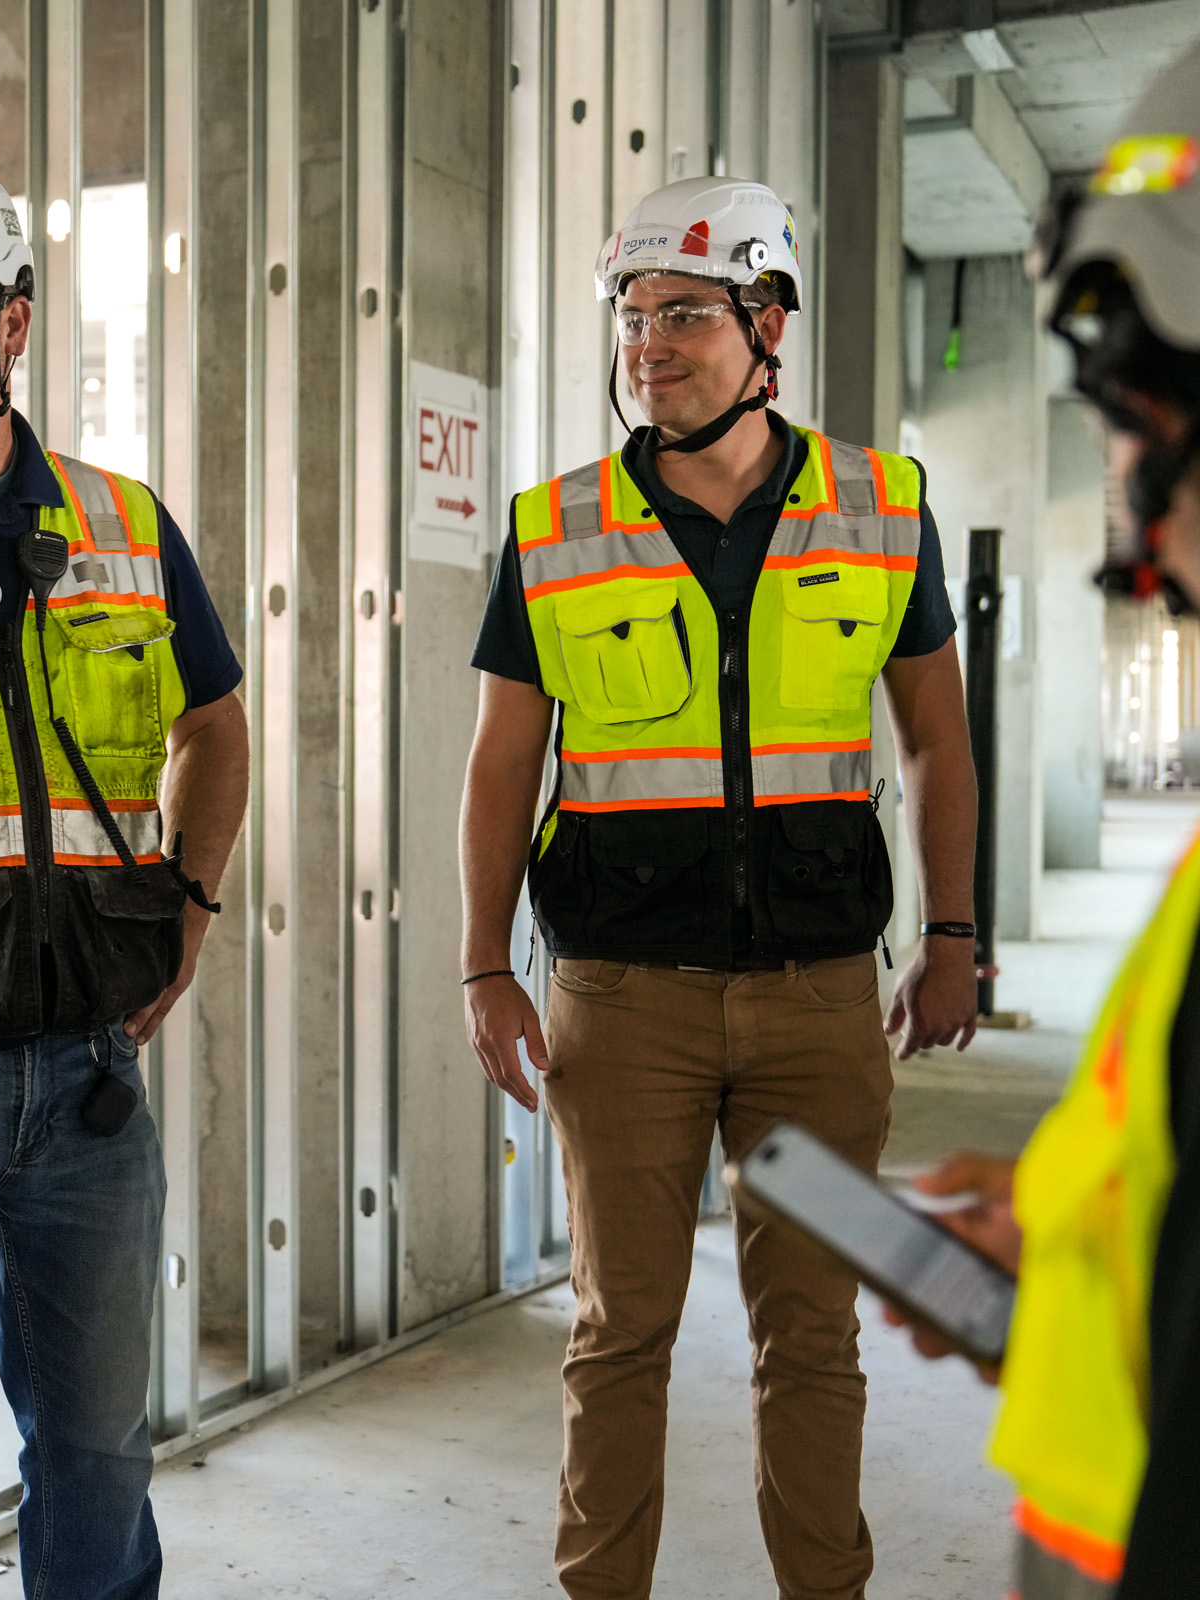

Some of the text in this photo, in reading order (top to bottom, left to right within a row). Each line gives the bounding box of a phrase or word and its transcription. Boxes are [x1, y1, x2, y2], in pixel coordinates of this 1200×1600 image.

[623, 237, 668, 249] POWER
[419, 407, 479, 480] EXIT
[800, 575, 838, 586] BLACK SERIES
